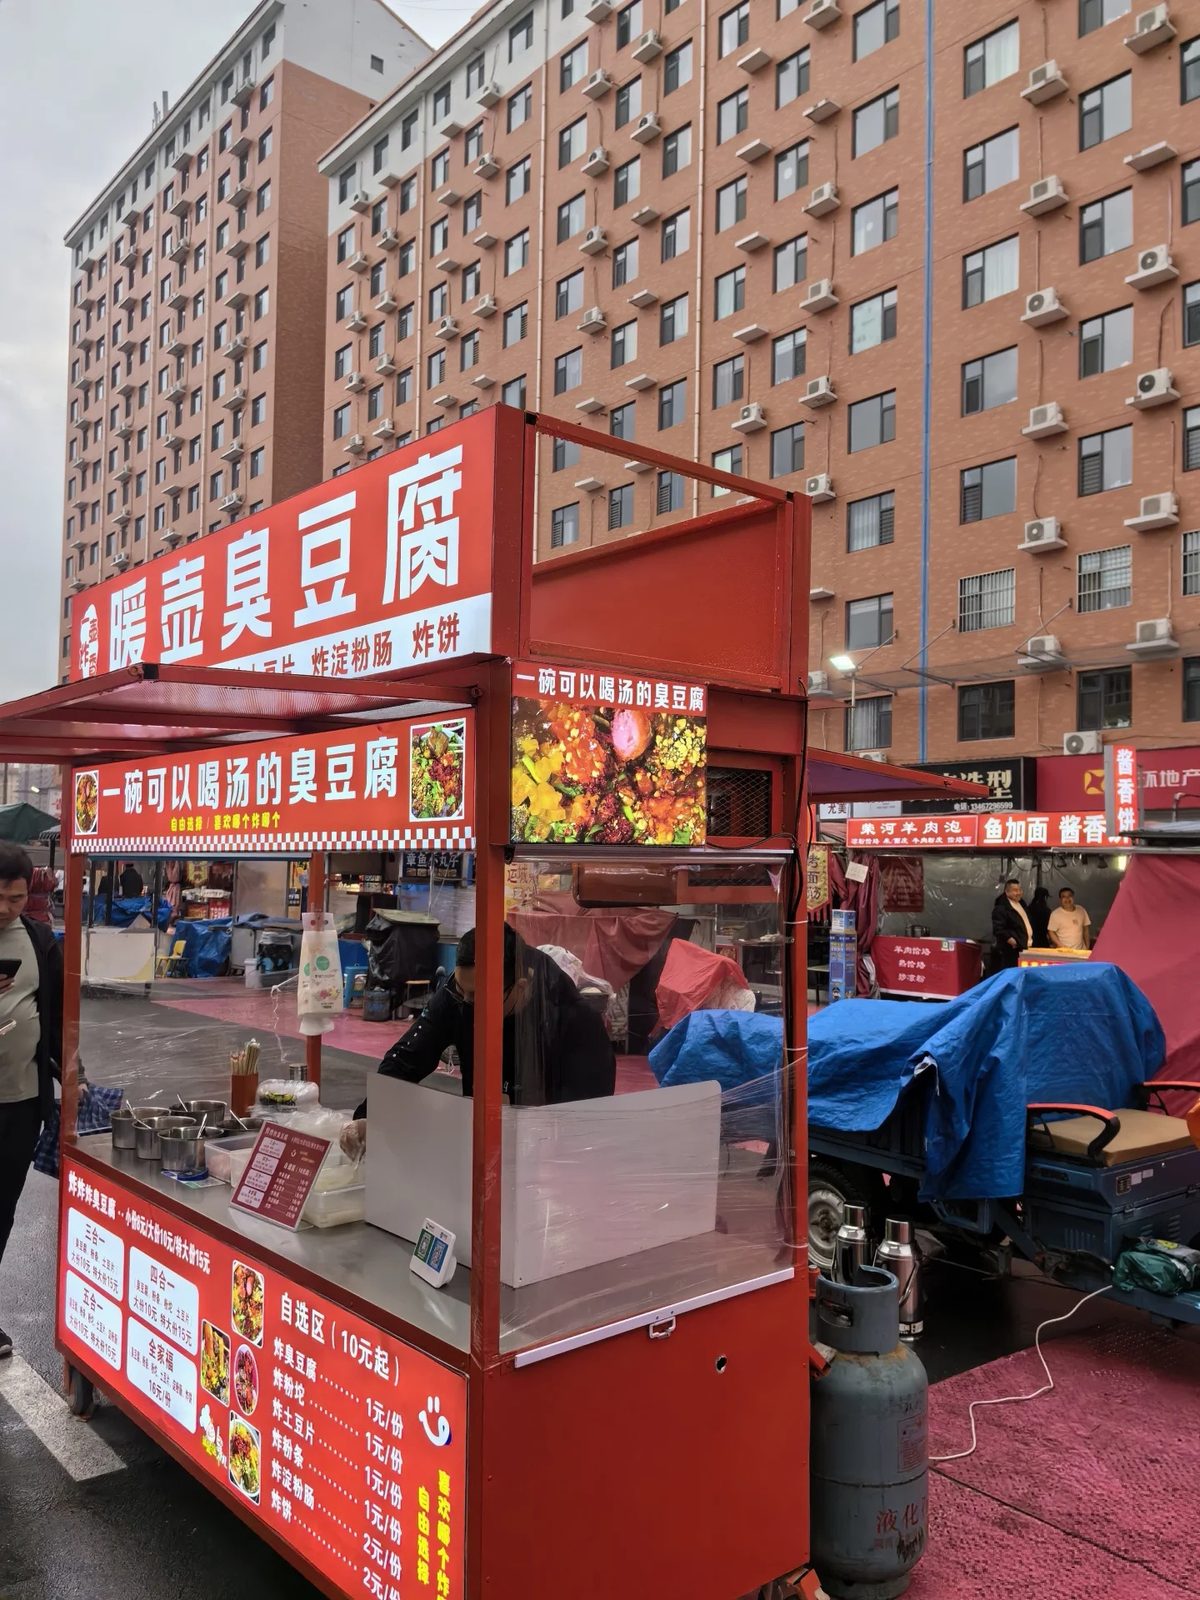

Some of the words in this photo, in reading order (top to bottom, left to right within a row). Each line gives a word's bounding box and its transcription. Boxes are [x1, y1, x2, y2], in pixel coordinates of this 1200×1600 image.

[109, 444, 463, 670] 暖壶臭豆腐
[312, 630, 393, 676] 炸淀粉肠
[412, 612, 460, 659] 炸饼
[517, 667, 705, 712] 一碗可以喝汤的臭豆腐
[102, 736, 398, 815] 一碗可以喝汤的臭豆腐
[1116, 748, 1135, 832] 酱香饼
[983, 816, 1050, 844] 鱼加面
[1059, 815, 1130, 843] 酱香
[85, 1223, 106, 1246] 三合一
[83, 1287, 104, 1311] 五合一
[150, 1264, 175, 1292] 四合一
[148, 1338, 174, 1373] 全家福
[274, 1337, 317, 1383] 炸臭豆腐
[366, 1397, 404, 1439] 1元/份
[272, 1397, 315, 1446] 炸土豆片
[365, 1466, 403, 1509] 1元/份
[273, 1366, 306, 1407] 炸粉坨
[365, 1431, 403, 1474] 1元/份
[270, 1488, 292, 1524] 炸饼
[271, 1458, 315, 1510] 炸淀粉肠
[363, 1533, 402, 1581] 2元/份
[272, 1427, 304, 1469] 炸粉条
[364, 1499, 403, 1545] 1元/份
[877, 1498, 926, 1534] 液化
[417, 1485, 430, 1585] 自由选择
[437, 1469, 451, 1600] 喜欢哪个炸
